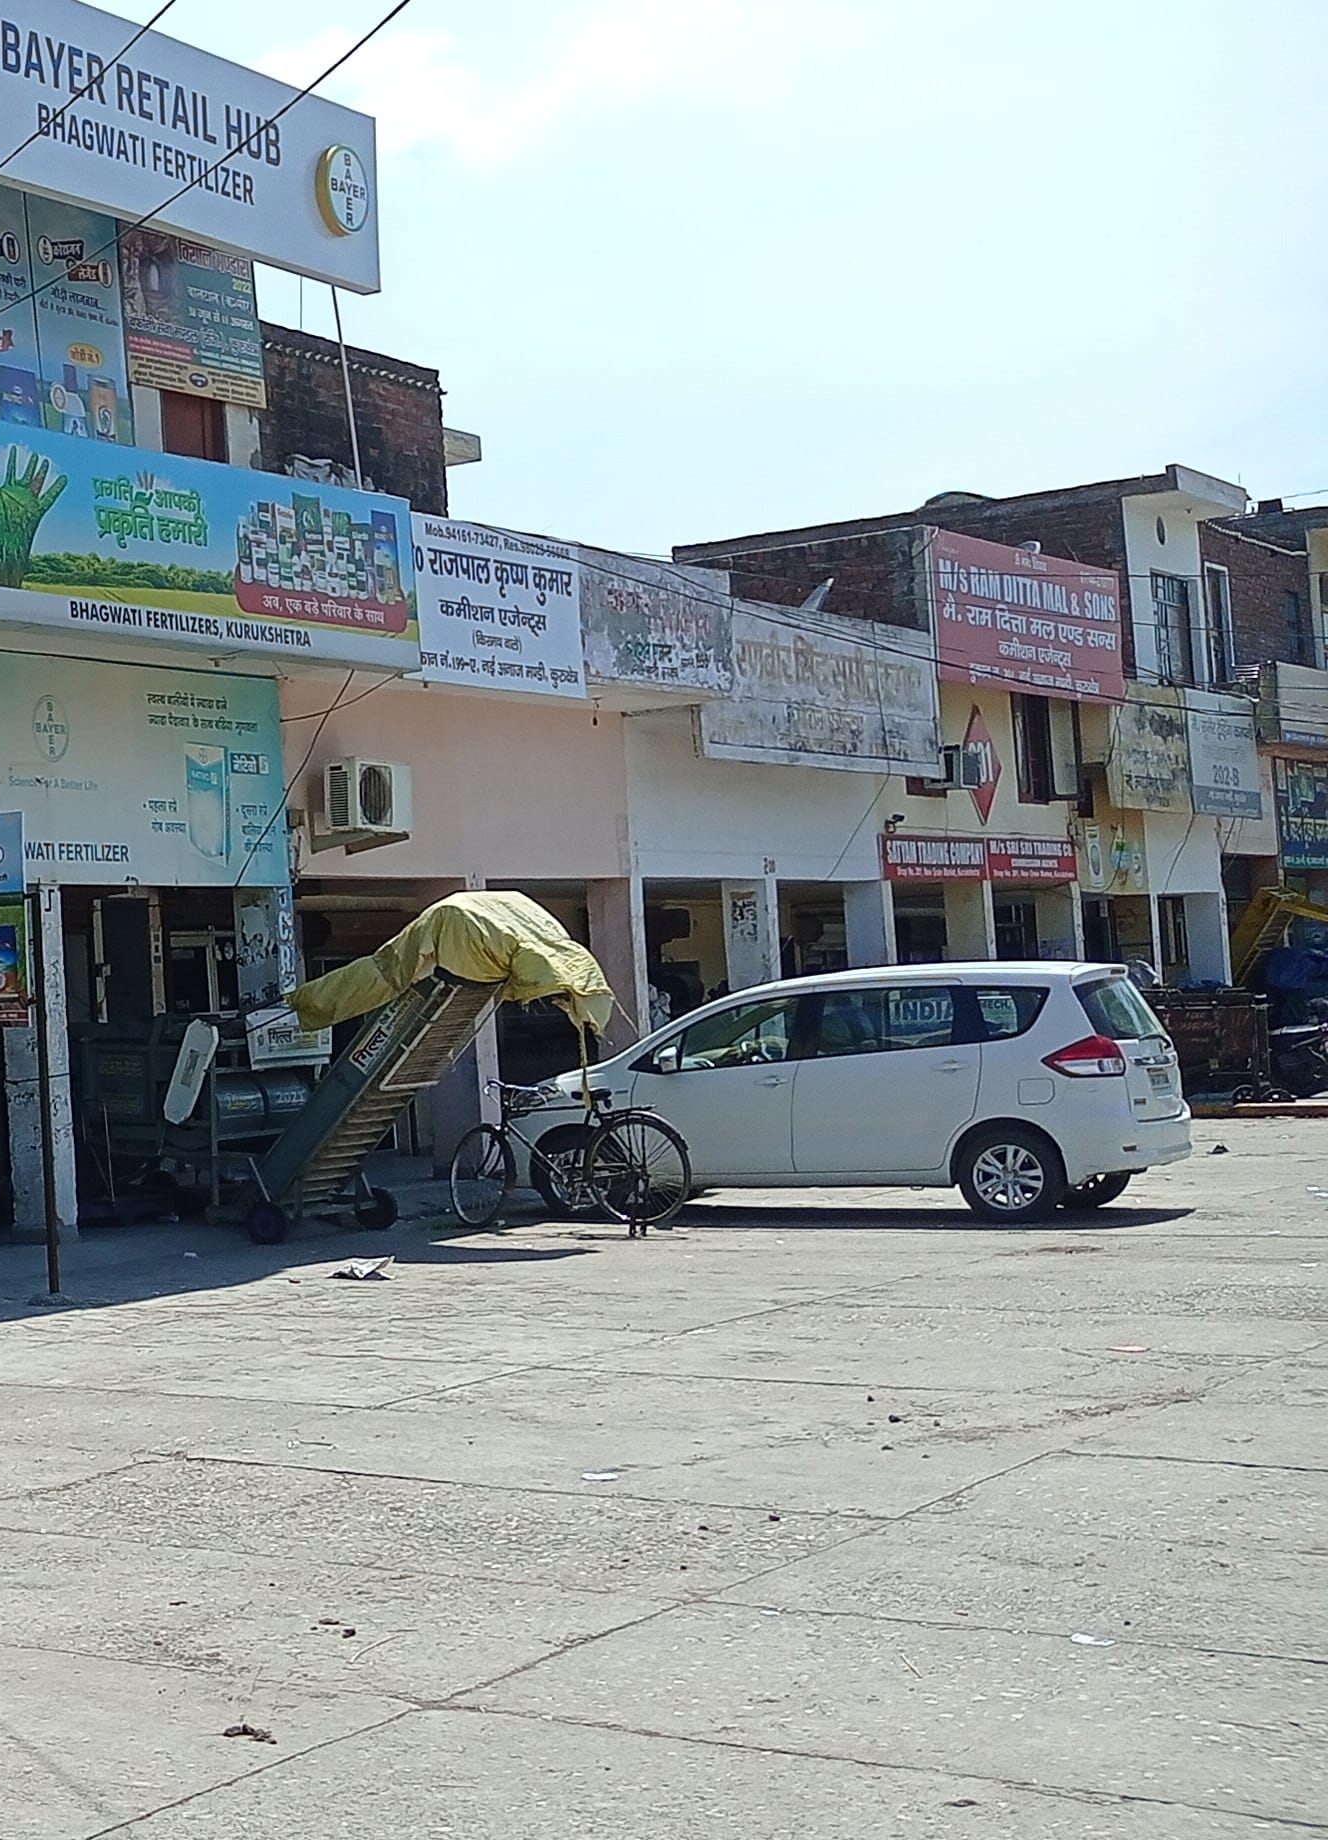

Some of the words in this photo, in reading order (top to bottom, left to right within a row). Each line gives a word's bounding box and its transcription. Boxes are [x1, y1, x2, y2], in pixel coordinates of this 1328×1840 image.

[0, 18, 107, 107] BAYER
[116, 64, 217, 146] RETAIL
[225, 100, 282, 168] HUB
[36, 102, 147, 172] BHAGWATI
[152, 143, 256, 206] FERTILIZER
[330, 177, 366, 201] BAYER
[91, 474, 135, 502] प्रगति
[94, 505, 155, 550] प्रकृति
[156, 514, 209, 548] हमारी
[427, 547, 491, 585] राजपाल
[493, 559, 530, 599] कृष्ण
[532, 565, 573, 607] कुमार
[938, 558, 967, 595] M/s
[970, 565, 1001, 601] RAM
[1003, 573, 1040, 609] DITTA
[1043, 581, 1069, 616] MAL
[1070, 592, 1081, 616] &
[1084, 590, 1117, 623] SONS
[69, 600, 144, 631] BHAGWATI
[145, 608, 224, 641] FERTILIZERS,
[225, 620, 312, 648] KURUKSHETRA
[321, 599, 353, 621] परिवार
[438, 595, 495, 624] कमीशन
[966, 604, 992, 629] राम
[1029, 616, 1056, 642] मल
[25, 841, 57, 861] WATI
[58, 843, 130, 863] FERTILIZER
